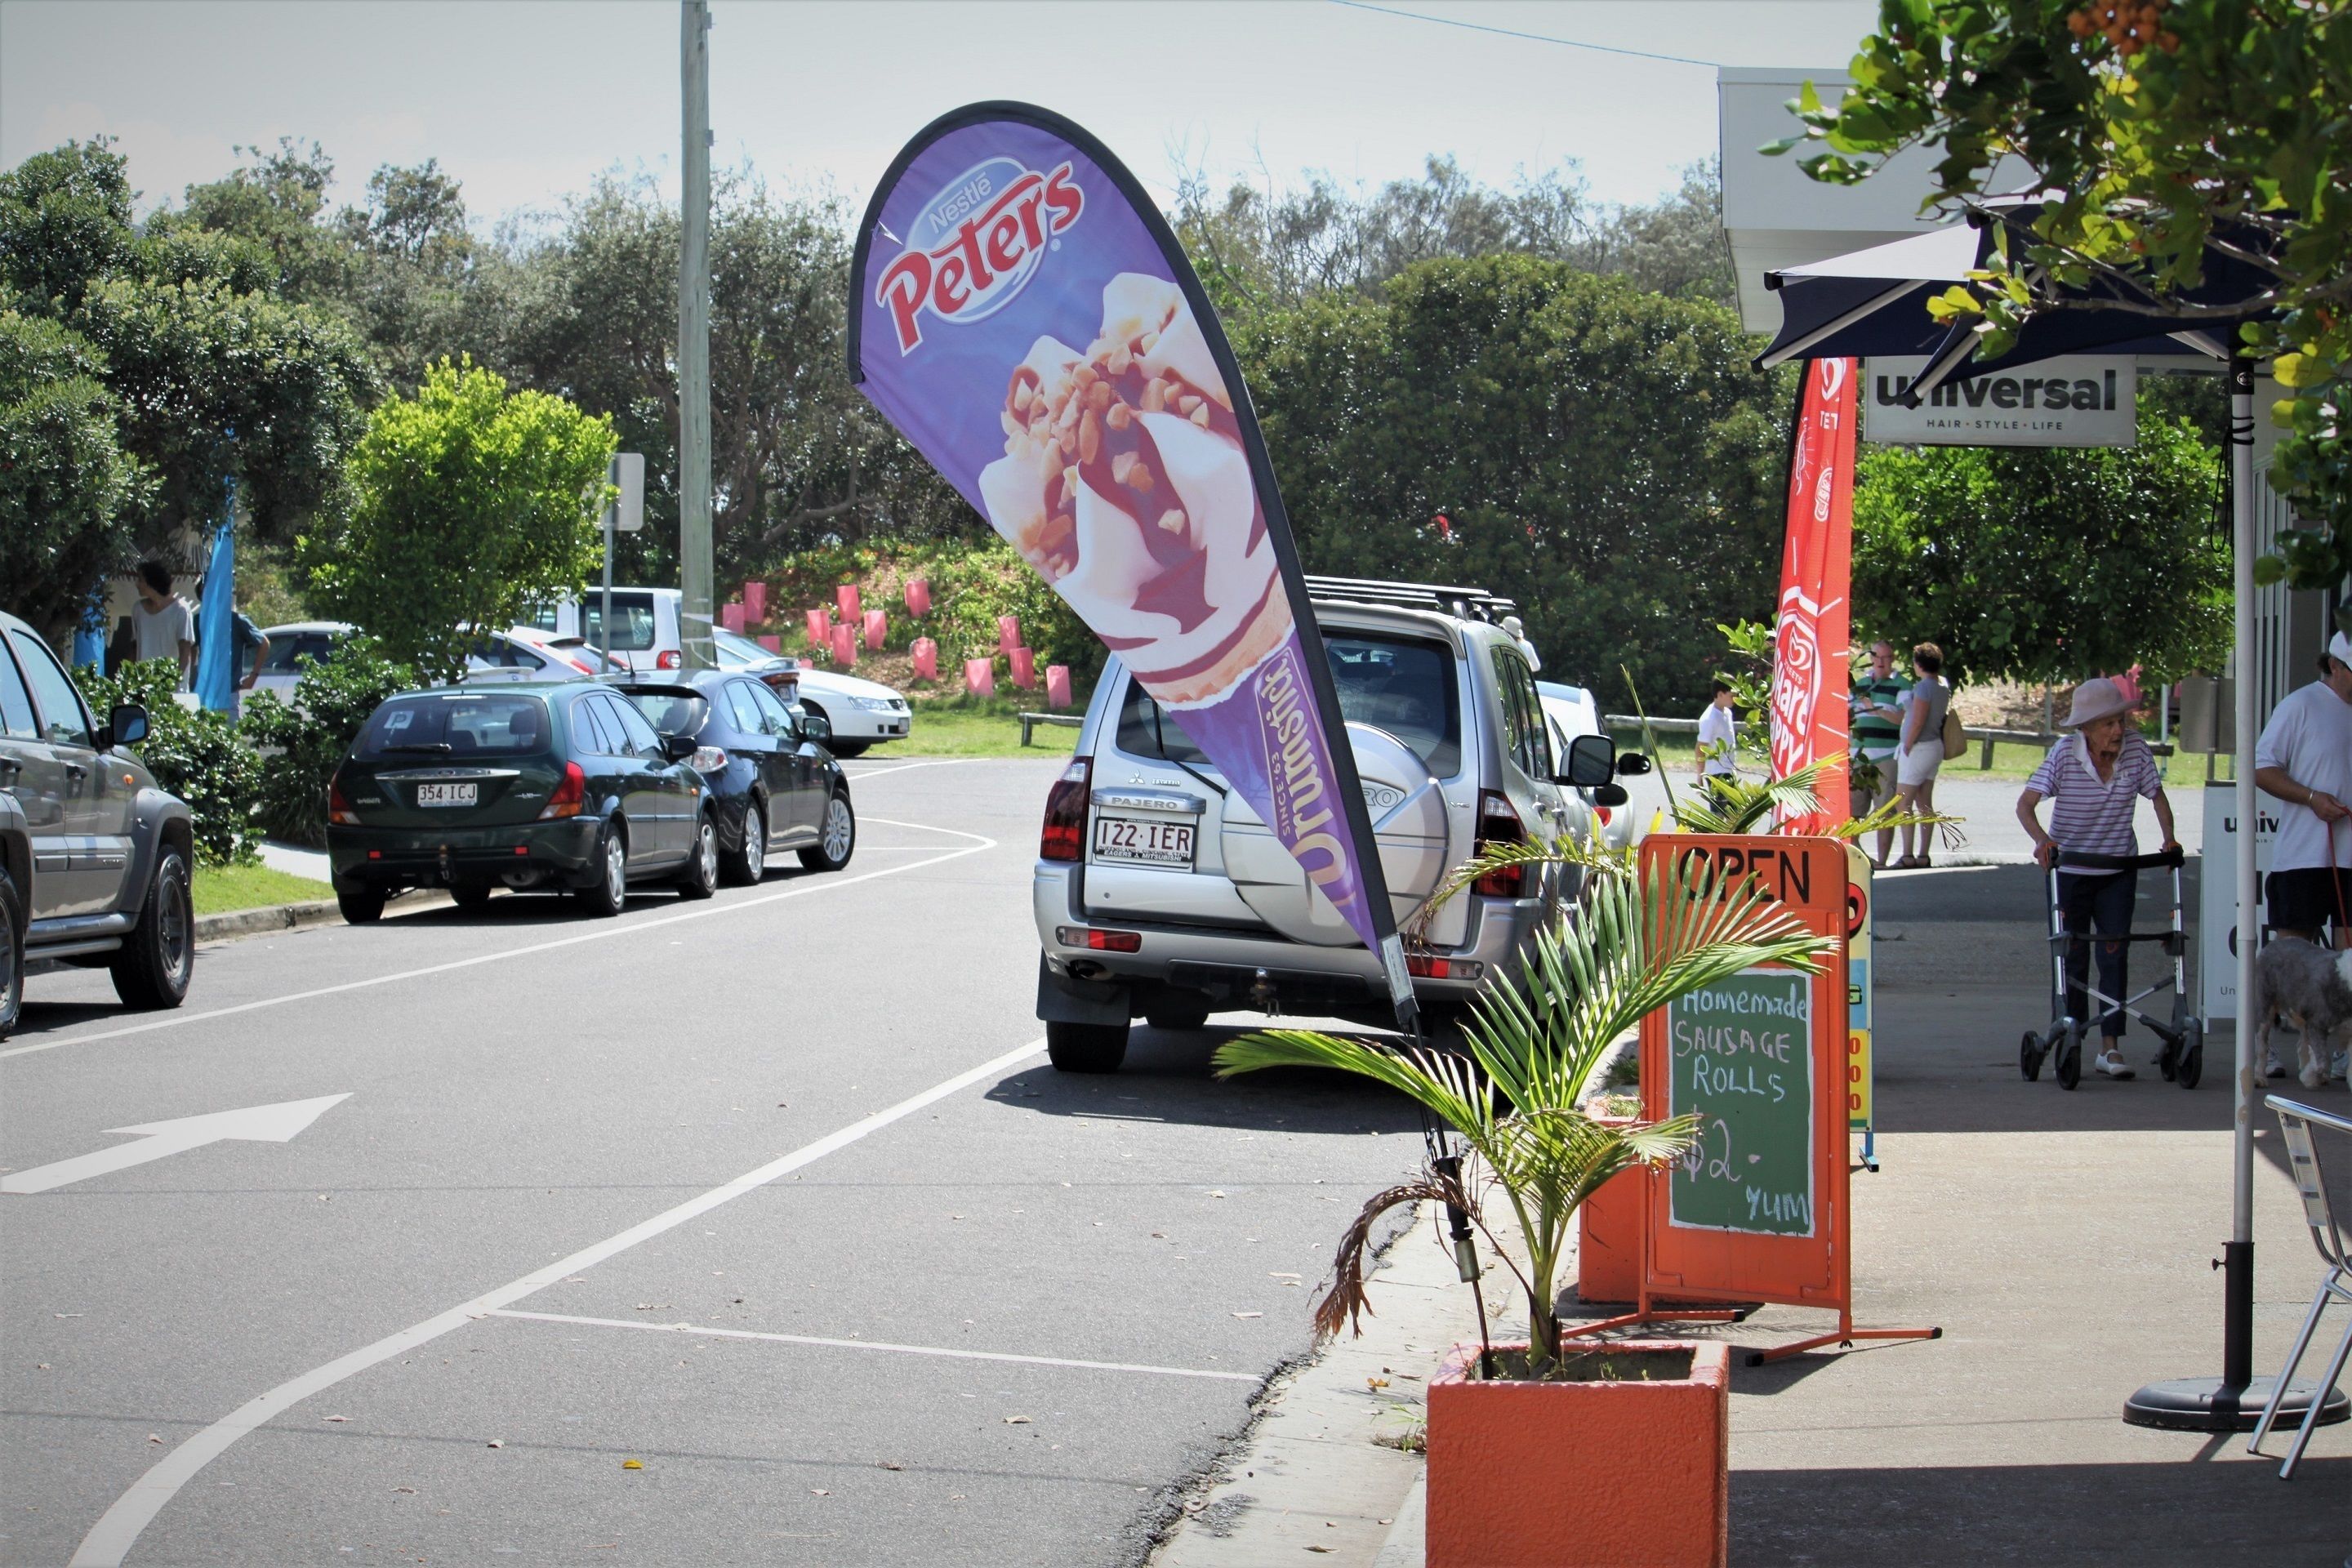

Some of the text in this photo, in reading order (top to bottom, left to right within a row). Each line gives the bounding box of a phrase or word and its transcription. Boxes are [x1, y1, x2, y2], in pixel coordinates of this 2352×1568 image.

[928, 171, 992, 234] Nestlé
[878, 165, 1082, 352] Peters
[1927, 419, 2063, 430] HAIR STYLE LIFE
[1260, 657, 1348, 886] Drumstick
[1111, 796, 1178, 810] PAJERO
[1276, 781, 1291, 836] SINCE
[1103, 849, 1133, 858] EAGERS
[1678, 846, 1810, 904] OPEN
[1682, 982, 1807, 1022] Homemade
[1675, 1019, 1791, 1063] SAUSAGE
[1692, 1054, 1786, 1102] ROLLS
[1745, 1184, 1809, 1225] YUM
